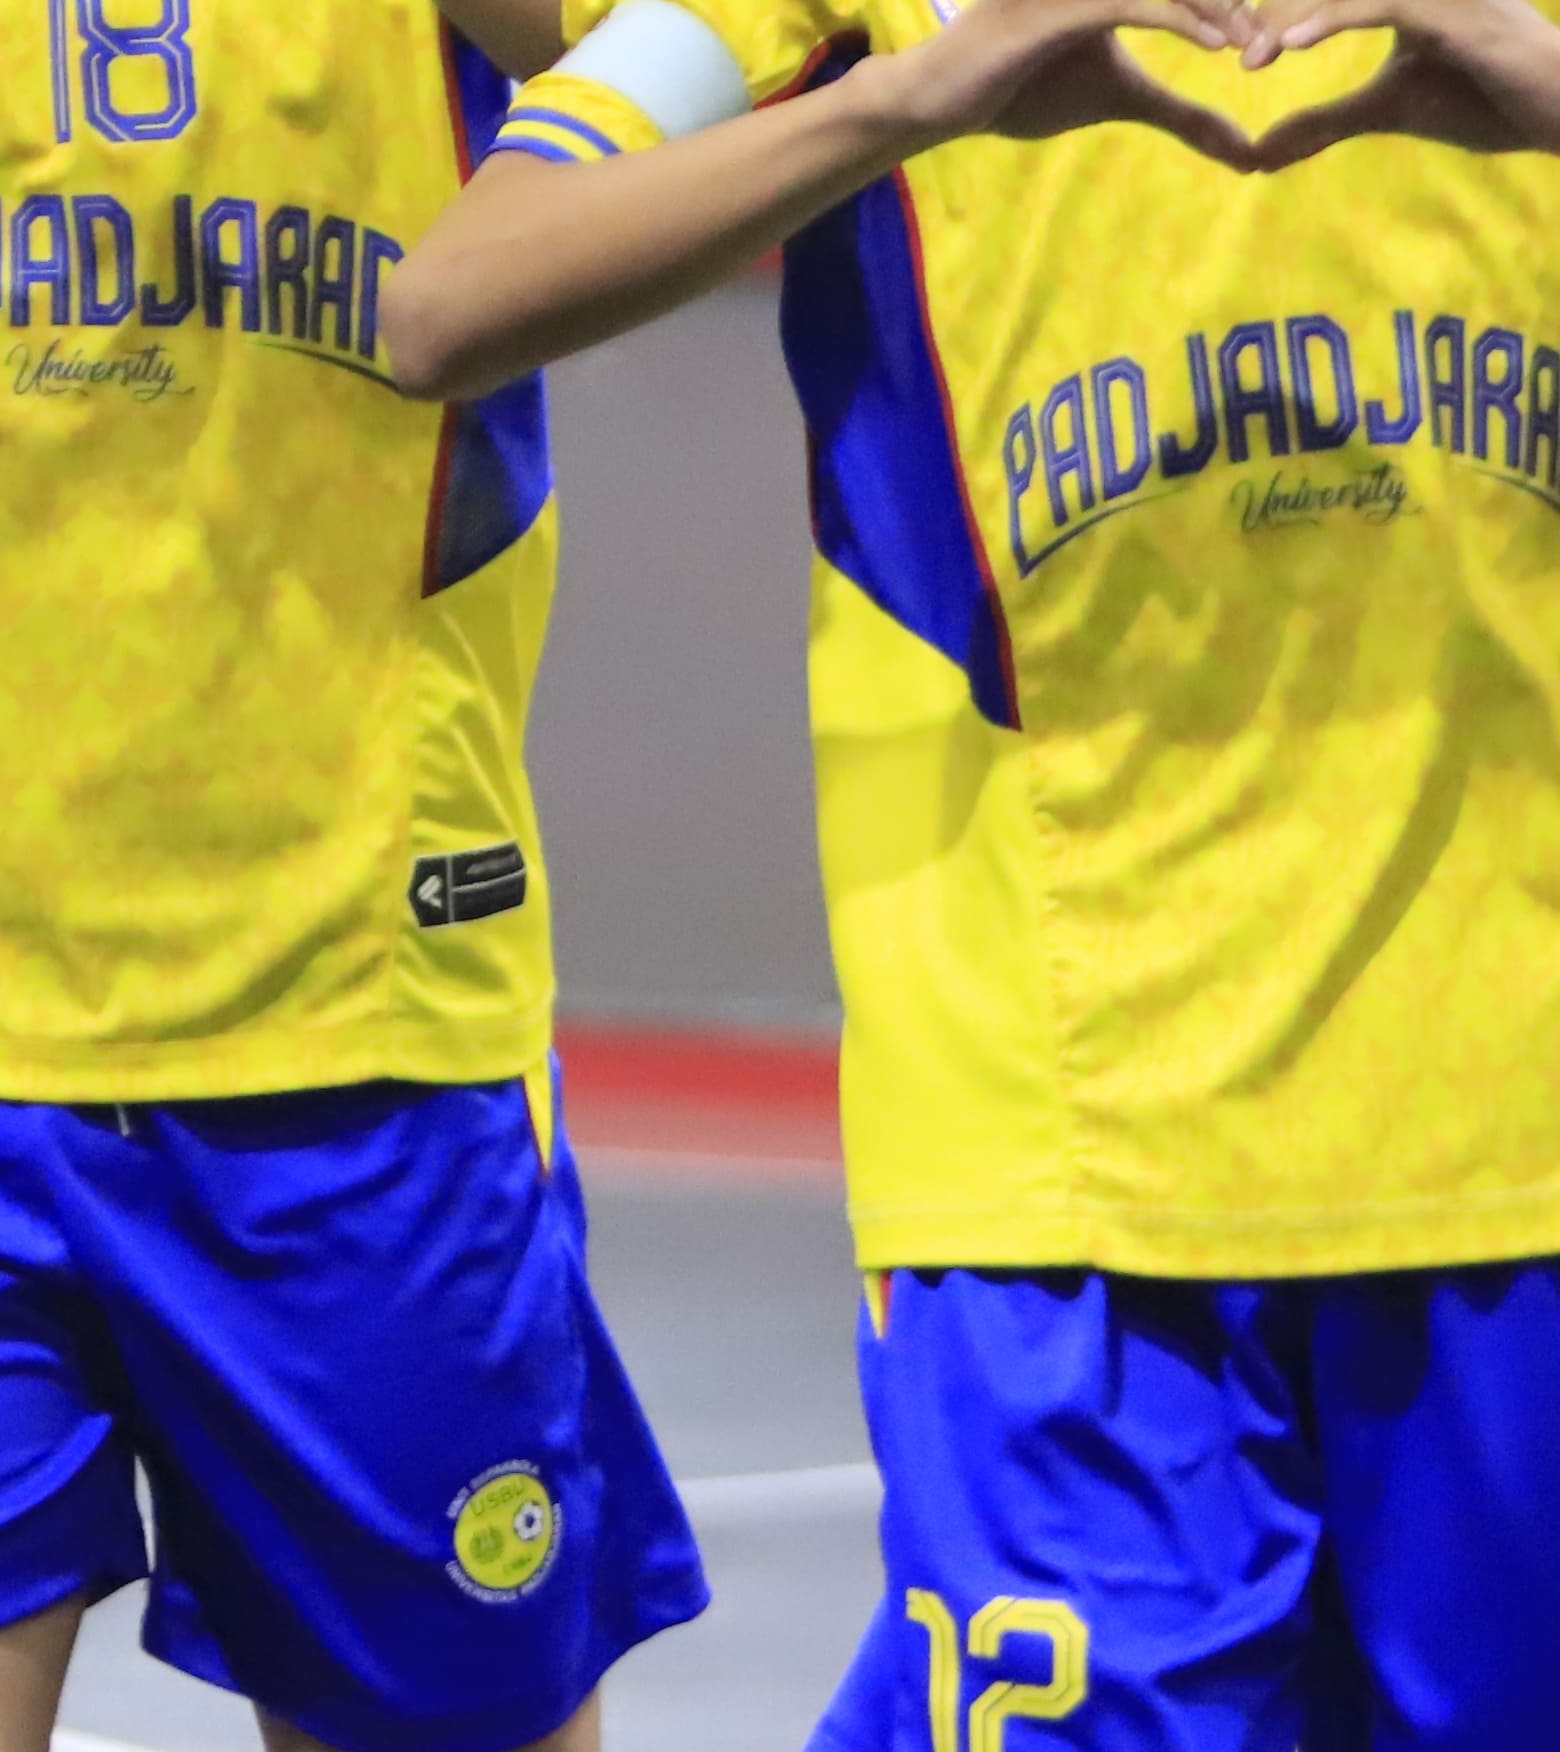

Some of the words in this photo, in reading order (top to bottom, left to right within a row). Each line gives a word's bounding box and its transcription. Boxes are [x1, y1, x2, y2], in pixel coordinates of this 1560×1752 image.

[4, 341, 197, 404] University
[1228, 460, 1424, 534] University
[906, 1588, 1089, 1752] 12
